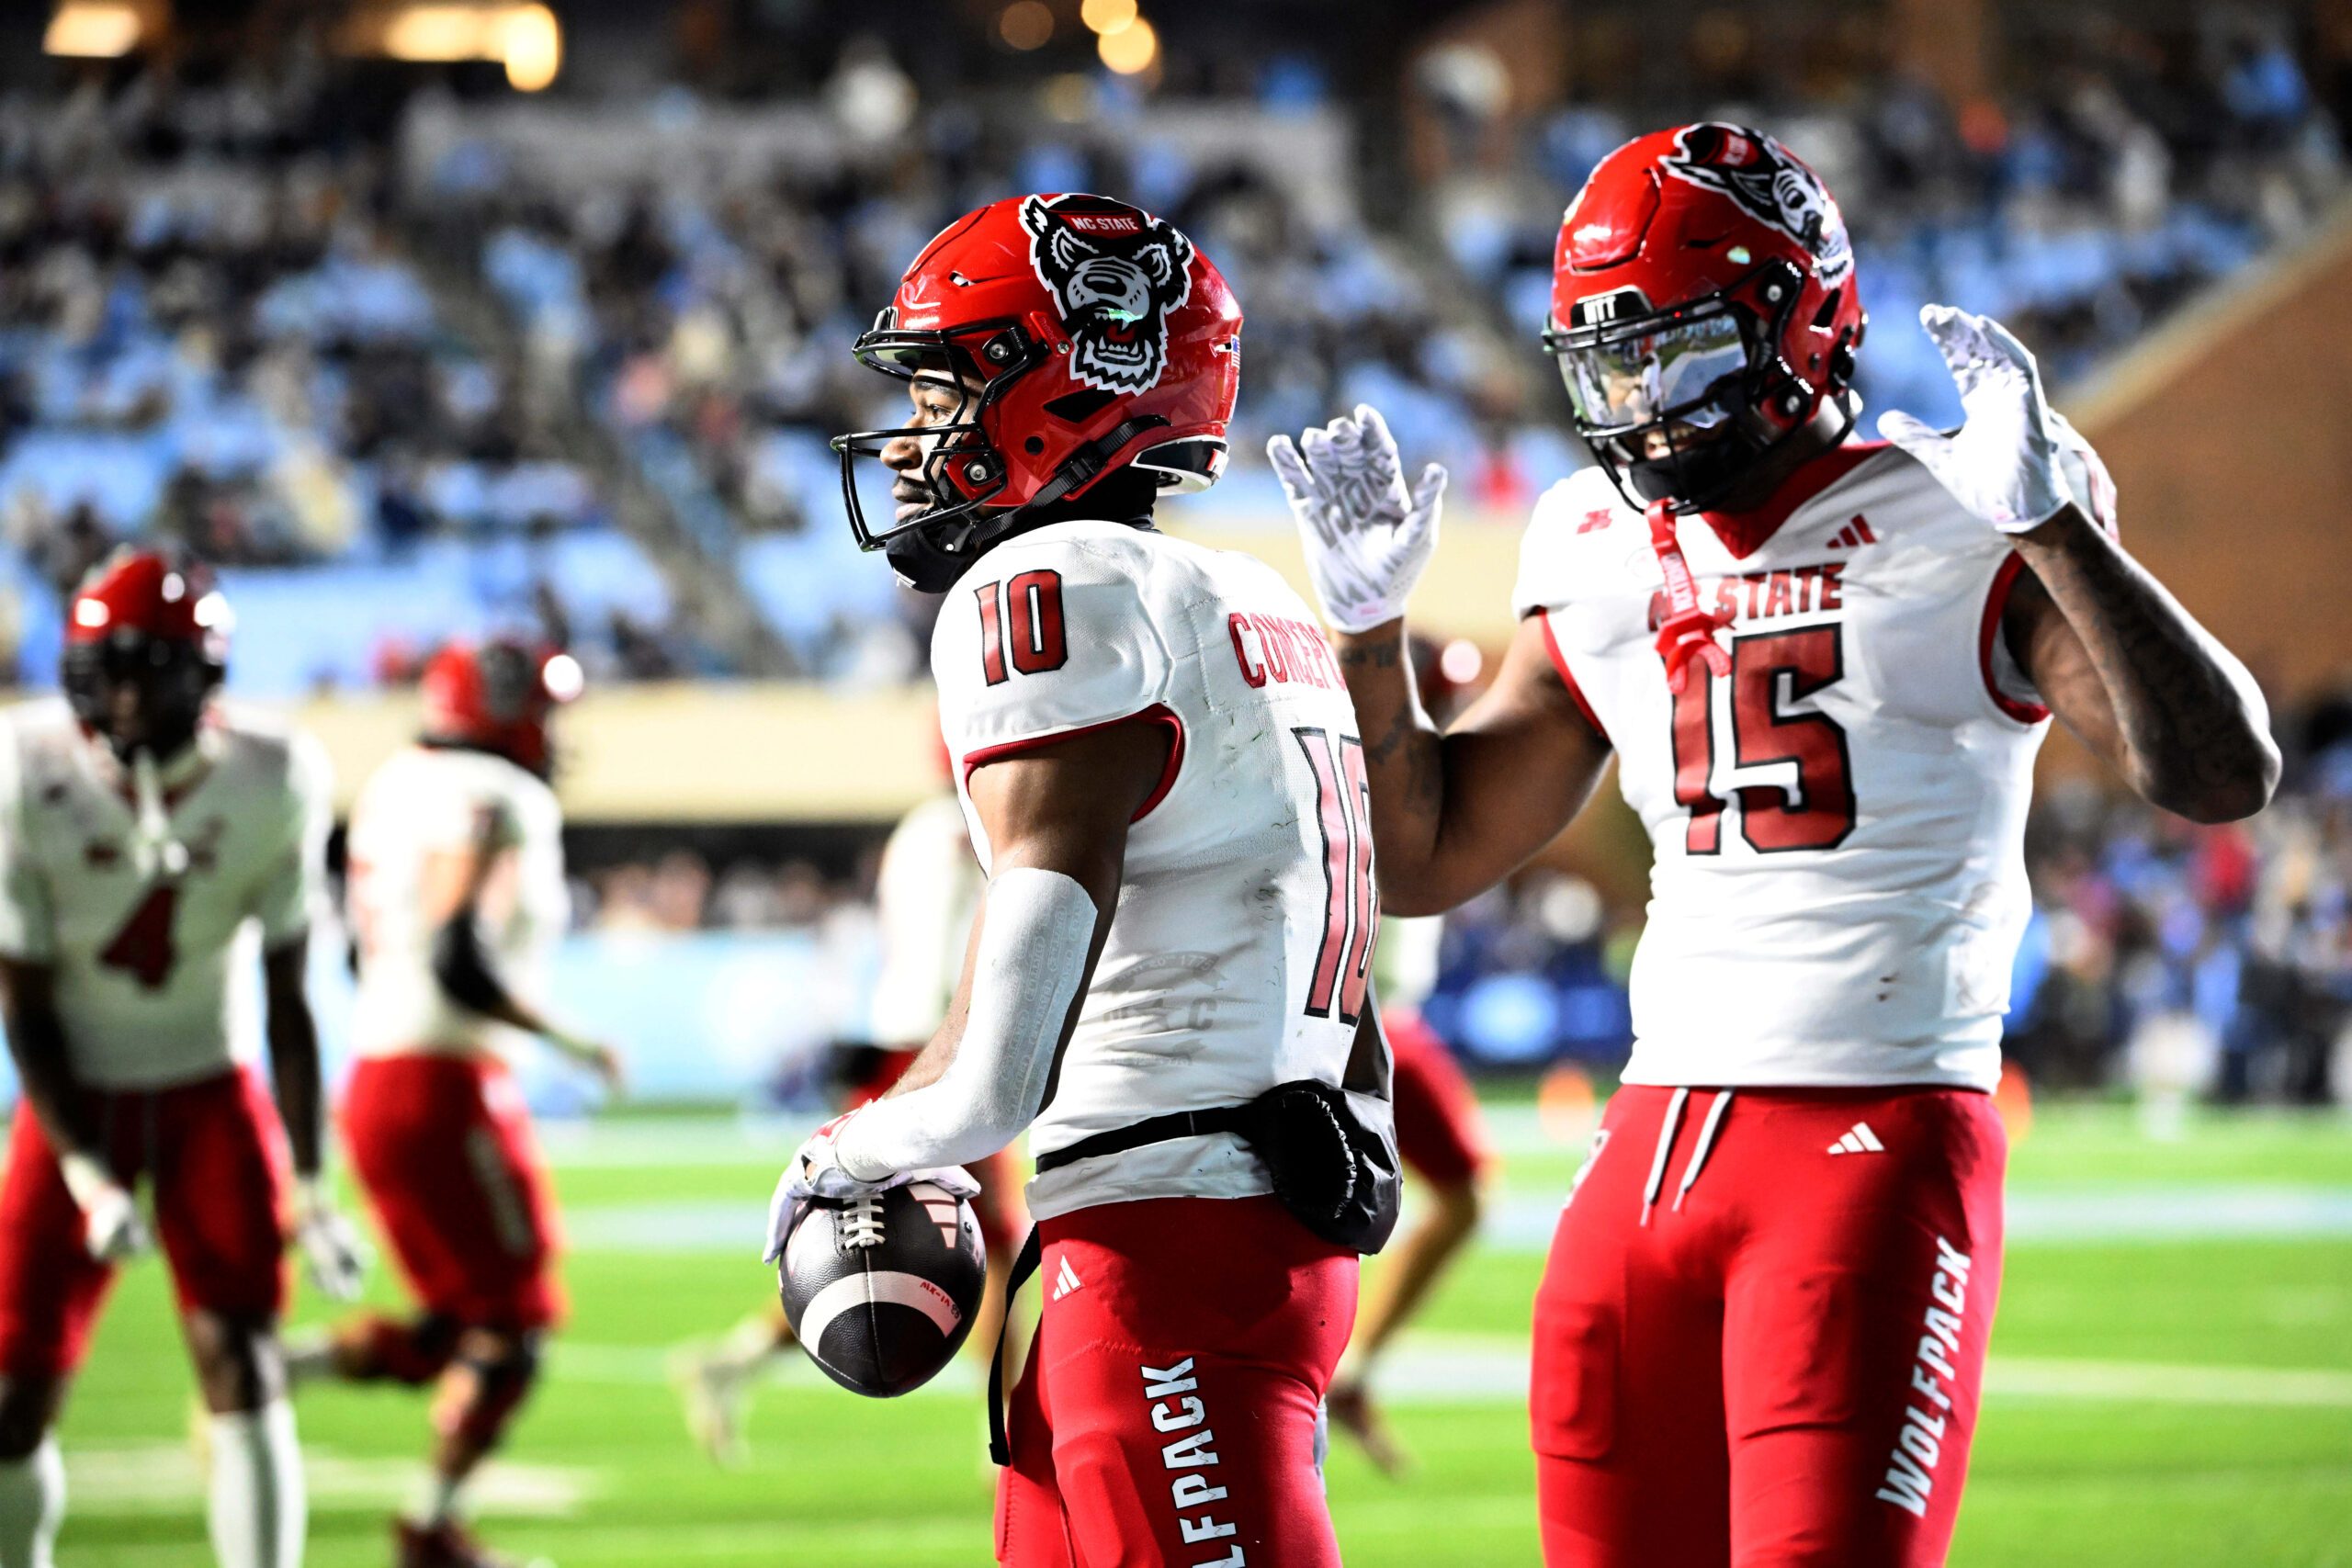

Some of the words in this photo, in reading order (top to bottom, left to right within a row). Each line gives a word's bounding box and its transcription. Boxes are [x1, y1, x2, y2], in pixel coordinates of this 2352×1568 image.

[1070, 217, 1097, 231] NC
[1096, 217, 1138, 231] STATE
[974, 569, 1068, 686] 10
[1714, 562, 1847, 625] STATE
[1664, 622, 1856, 855] 15
[100, 884, 179, 993] 4
[1876, 1236, 1972, 1518] WOLFPACK
